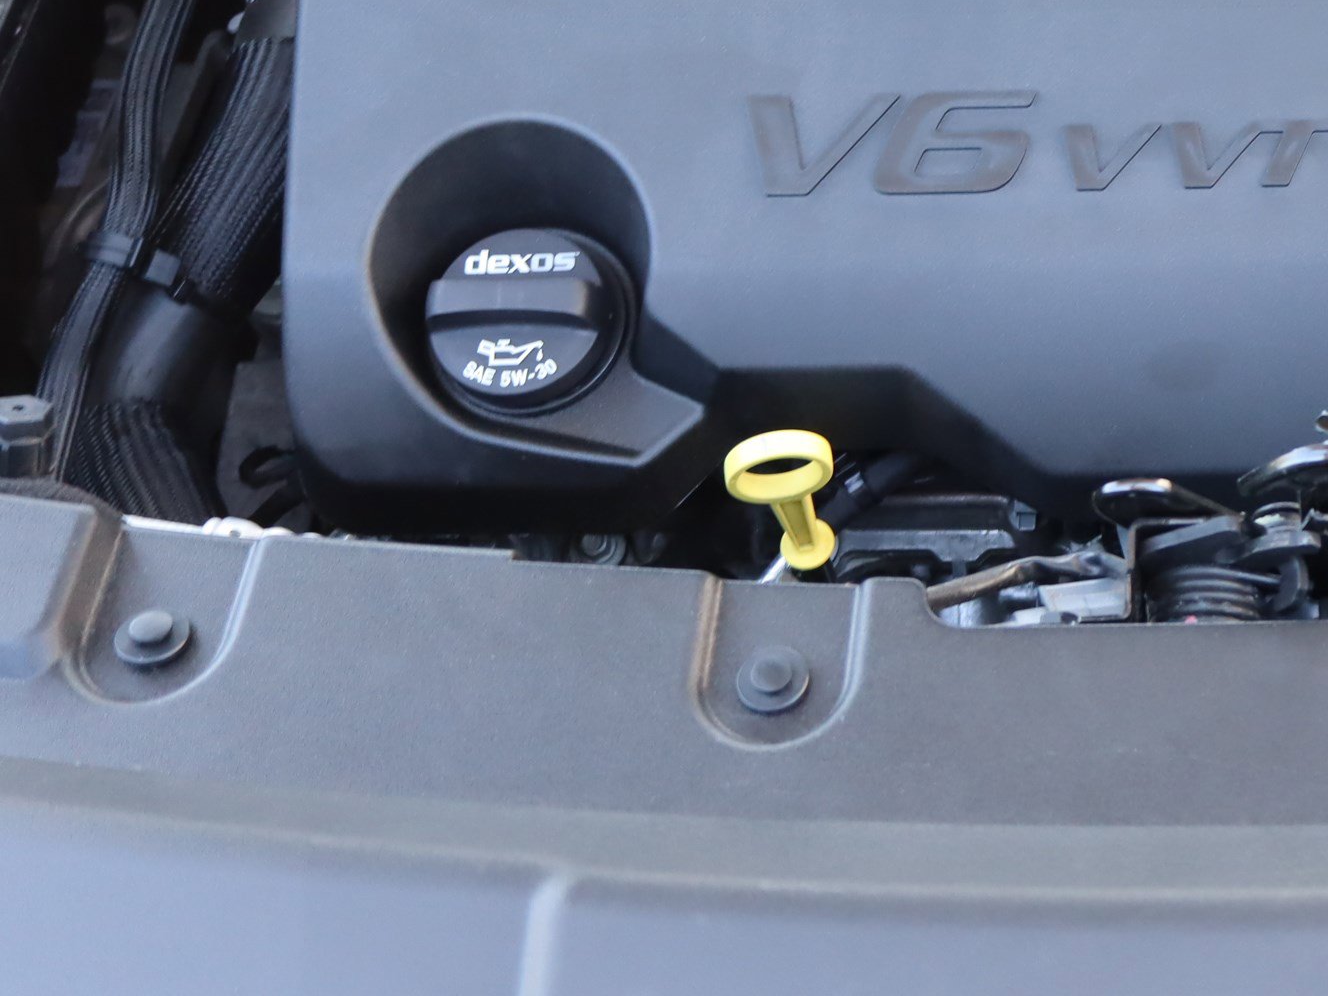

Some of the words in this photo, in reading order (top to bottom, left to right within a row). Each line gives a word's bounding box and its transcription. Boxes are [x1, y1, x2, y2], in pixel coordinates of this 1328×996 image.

[748, 89, 1038, 198] V6
[464, 249, 580, 275] dexos
[462, 360, 496, 386] SAE
[499, 358, 558, 388] 5W-30
